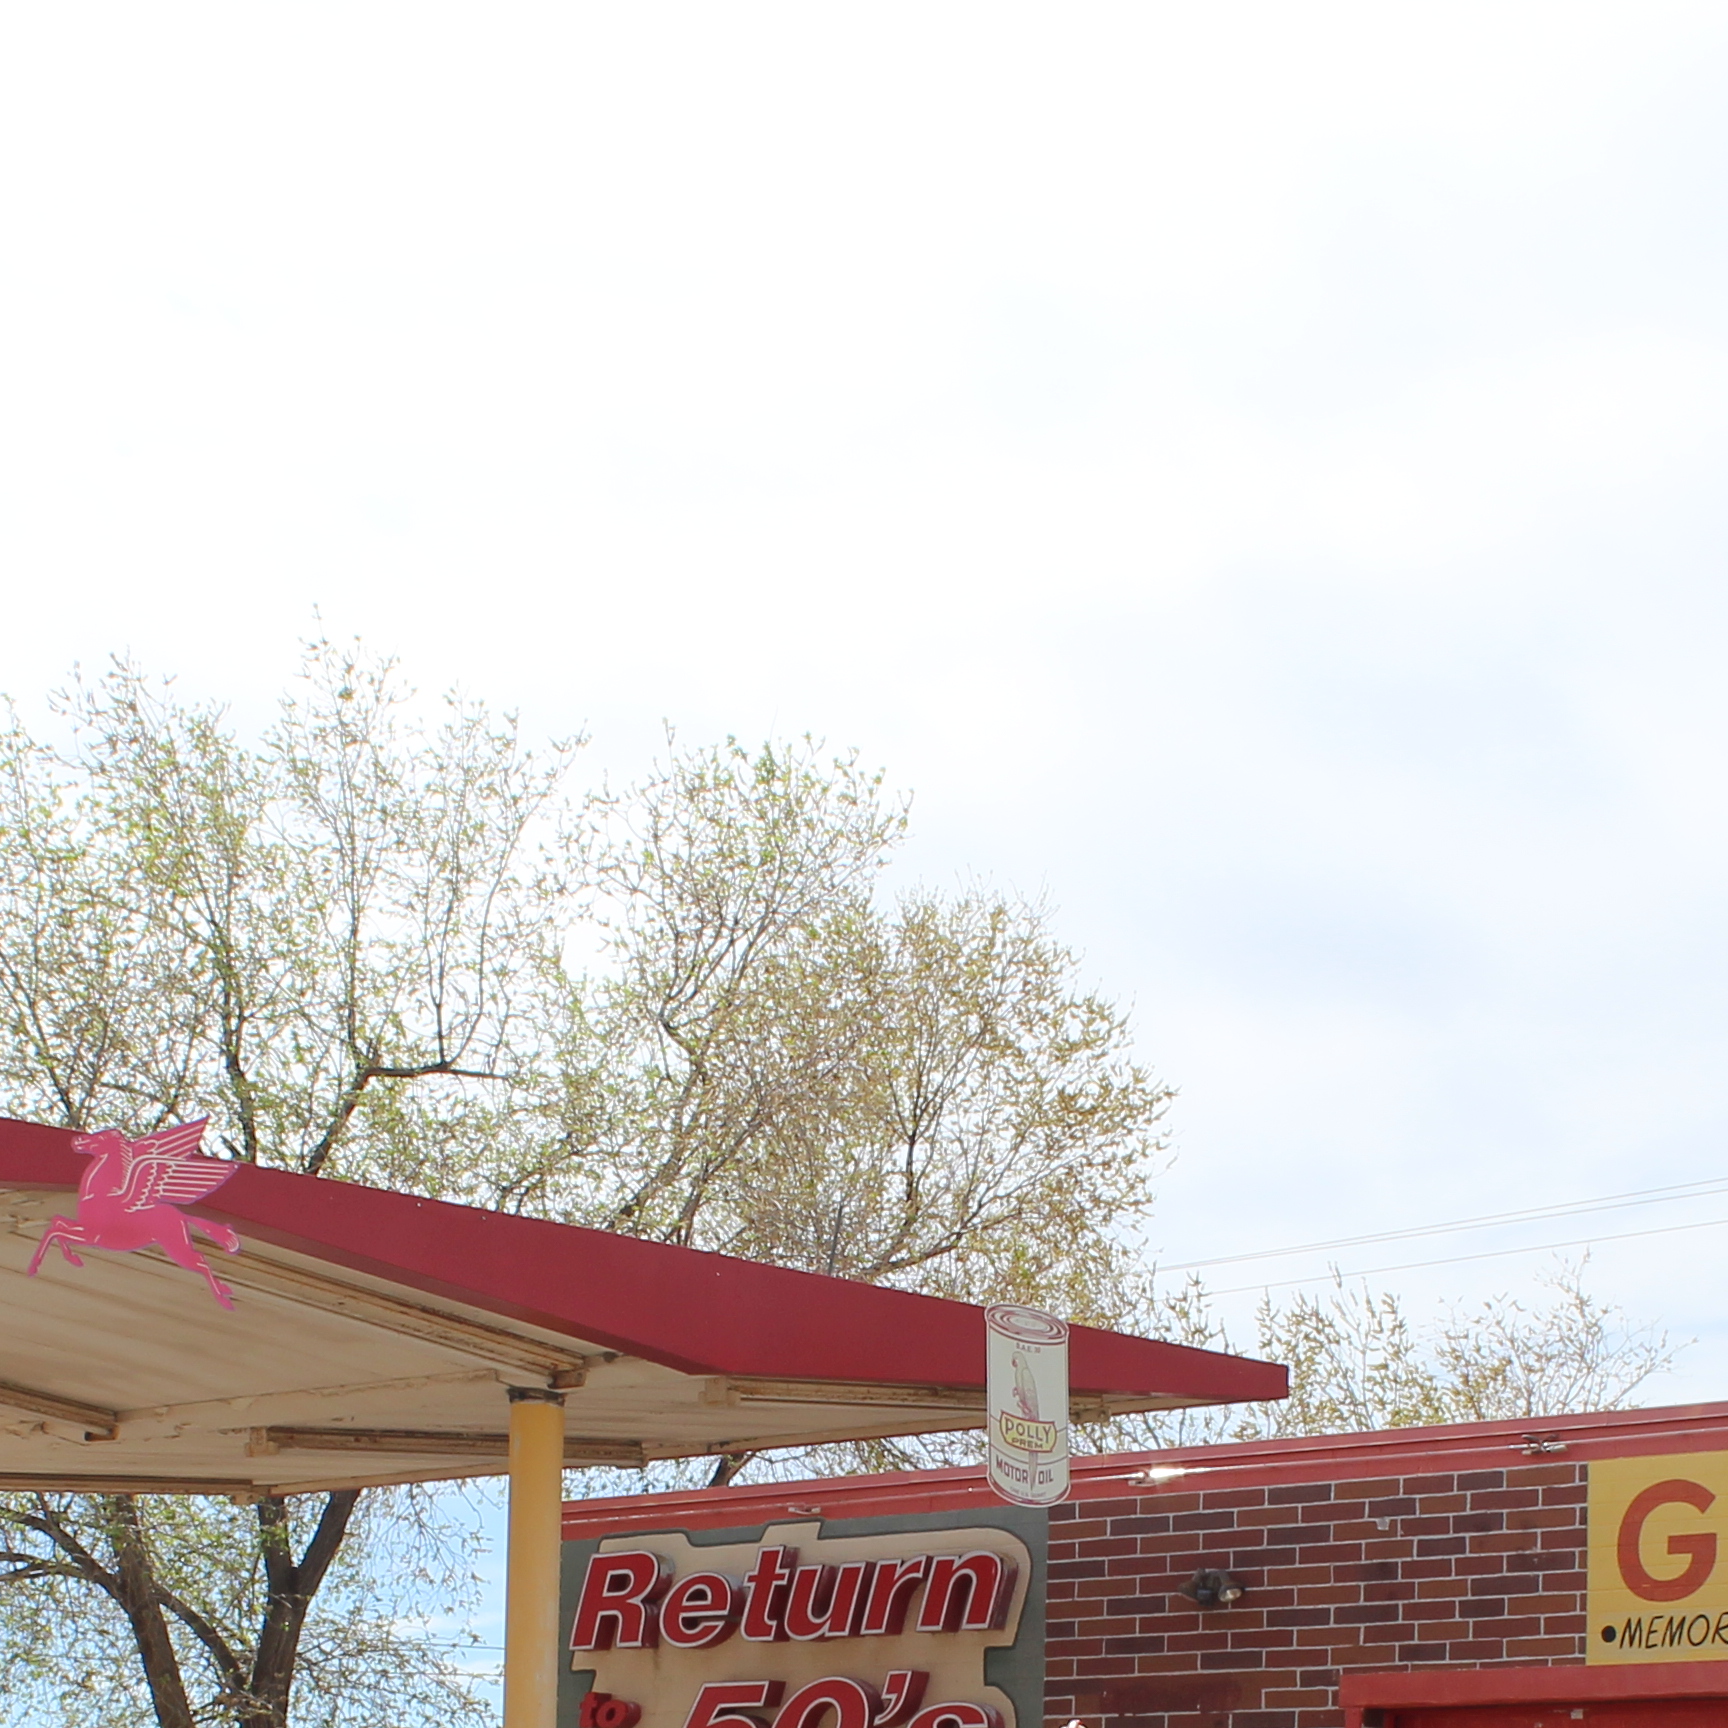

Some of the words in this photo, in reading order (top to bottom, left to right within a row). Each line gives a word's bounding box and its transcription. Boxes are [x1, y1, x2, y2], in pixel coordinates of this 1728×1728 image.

[1004, 1416, 1051, 1444] POLLY
[996, 1454, 1029, 1484] MOTOR
[1038, 1468, 1054, 1485] OIL
[569, 1545, 1010, 1652] Return
